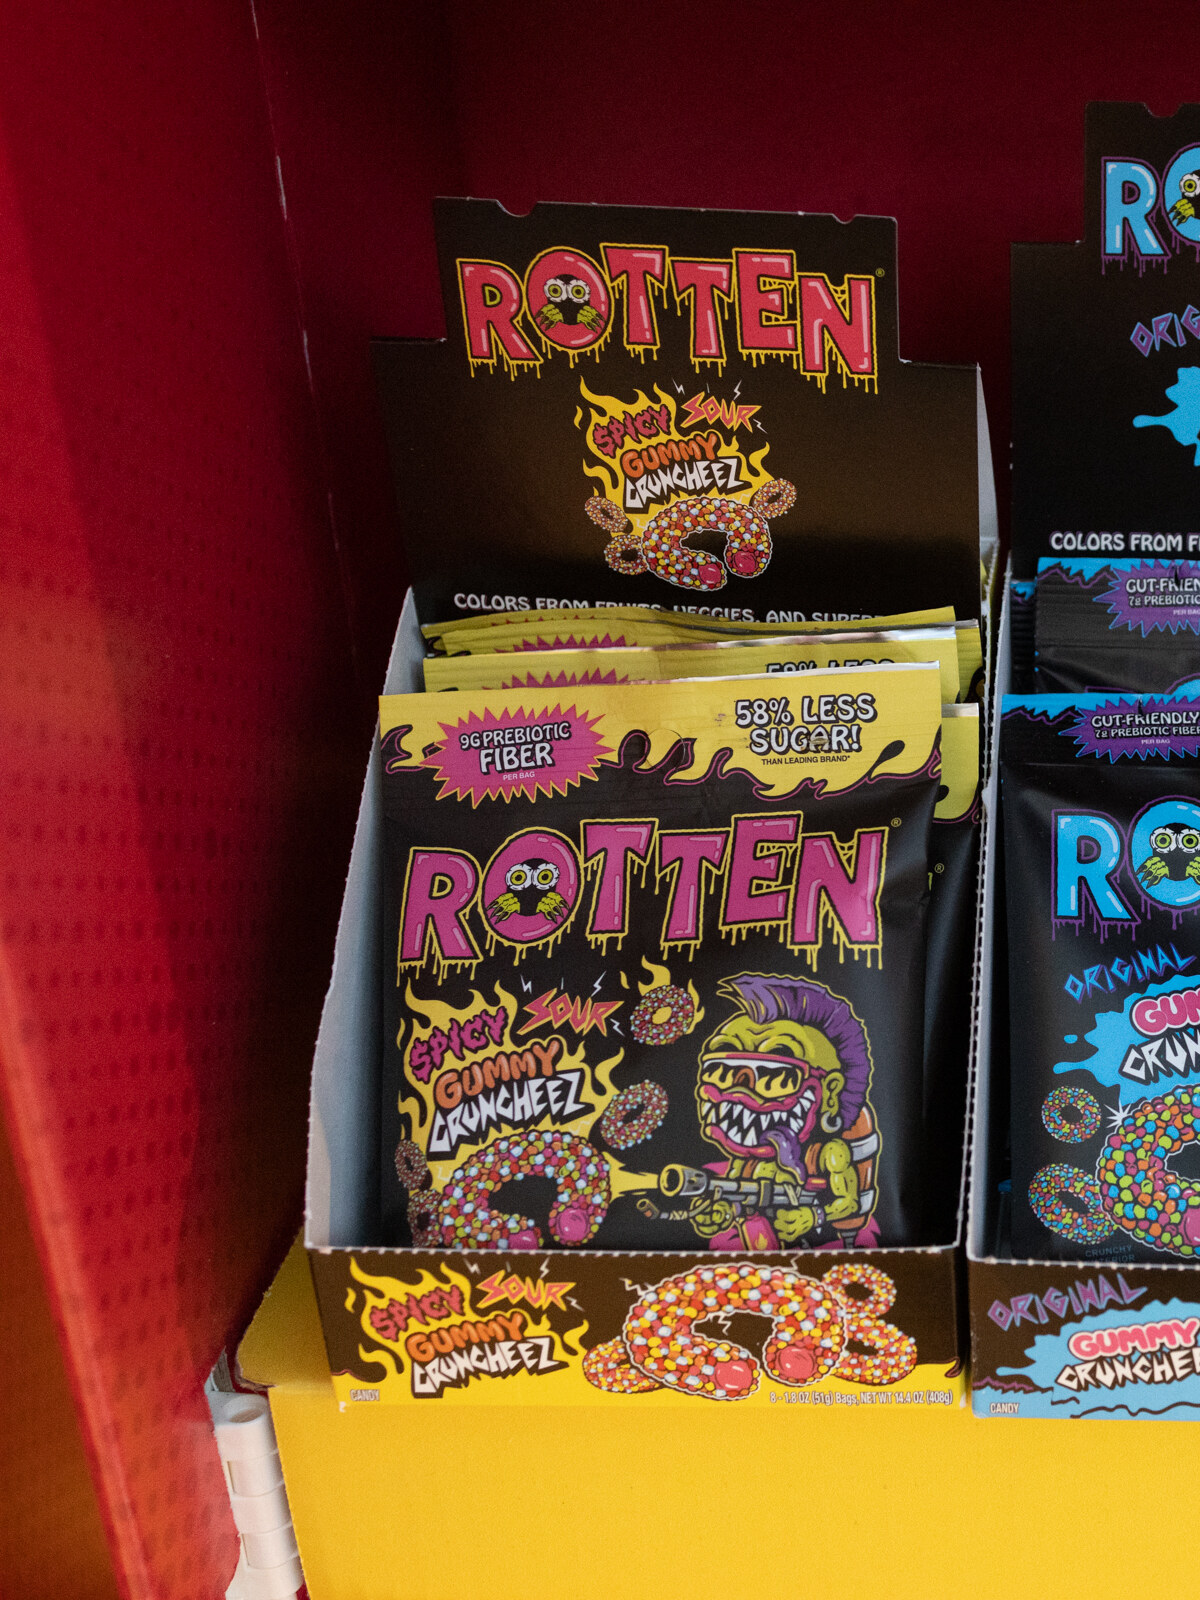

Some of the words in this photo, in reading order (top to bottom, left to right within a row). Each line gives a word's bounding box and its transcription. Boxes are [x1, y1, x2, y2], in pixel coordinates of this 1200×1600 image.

[456, 243, 877, 394] ROTTEN
[593, 404, 671, 459] SPICY
[680, 391, 762, 432] SOUR
[621, 433, 718, 478] GUMMY
[624, 457, 749, 511] CRUNCHEEZ
[1050, 531, 1125, 551] COLORS
[1130, 533, 1183, 551] FROM
[454, 593, 531, 611] COLORS
[536, 598, 589, 611] FROM
[766, 610, 806, 623] AND
[1144, 595, 1200, 606] PREBIOTIC
[736, 698, 792, 727] 58%
[802, 694, 876, 723] LESS
[483, 722, 571, 747] PREBIOTIC
[750, 725, 862, 754] SUGAR!
[1111, 727, 1169, 738] PREBIOTIC
[480, 742, 554, 774] FIBER
[785, 756, 818, 765] LEADING
[503, 773, 518, 781] PER
[519, 771, 535, 779] BAG
[397, 812, 888, 986] ROTTEN
[1064, 942, 1197, 1004] ORIGINAL
[410, 1006, 508, 1084] SPICY
[516, 988, 625, 1037] SOUR
[434, 1039, 561, 1109] GUMMY
[428, 1070, 589, 1153] CRUNCHEEZ
[1085, 1245, 1132, 1257] CRUNCHY
[370, 1284, 465, 1342] SPICY
[476, 1269, 577, 1311] SOUR
[987, 1272, 1149, 1332] ORIGINAL
[405, 1312, 524, 1363] GUMMY
[413, 1336, 563, 1395] CRUNCHEEZ
[350, 1389, 380, 1401] CANDY
[770, 1392, 777, 1403] 8
[784, 1392, 797, 1403] 1.8
[799, 1392, 811, 1404] OZ
[811, 1391, 834, 1406] (51g)
[835, 1392, 860, 1406] Bags,
[860, 1391, 878, 1404] NET
[879, 1391, 893, 1404] WT
[894, 1391, 911, 1404] 14.4
[913, 1391, 924, 1404] OZ
[926, 1390, 953, 1405] (408g)
[990, 1402, 1019, 1414] CANDY
